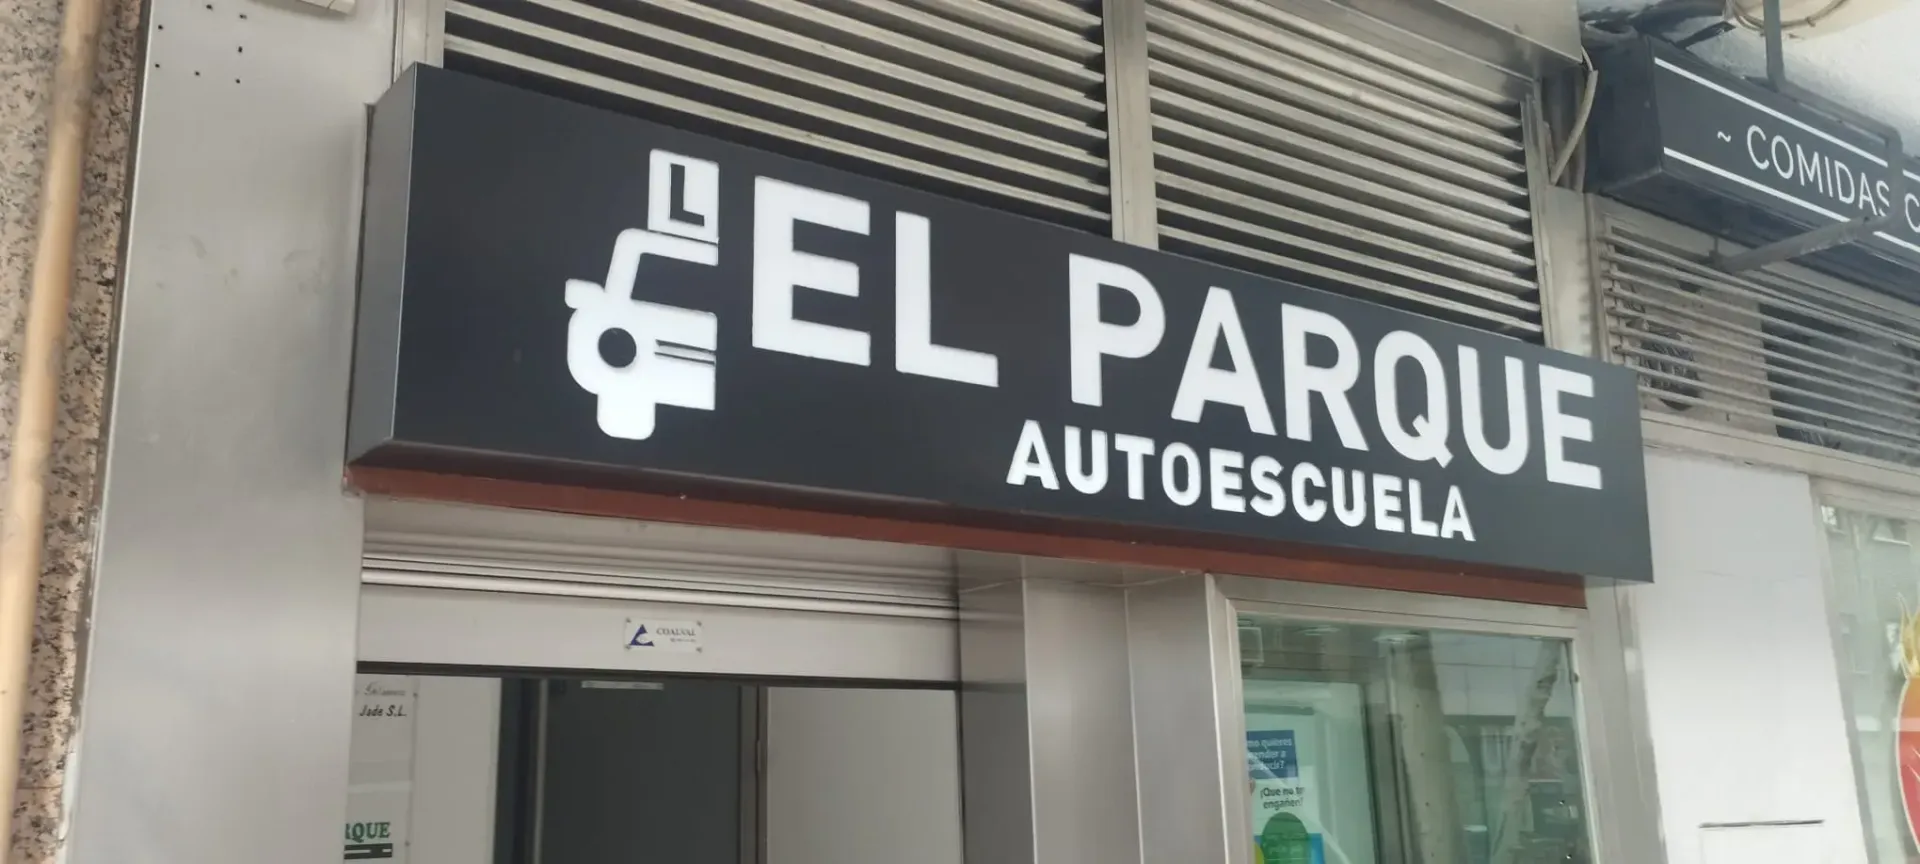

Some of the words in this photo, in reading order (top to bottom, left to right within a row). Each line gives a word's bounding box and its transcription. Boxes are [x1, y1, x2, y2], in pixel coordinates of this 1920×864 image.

[669, 163, 705, 227] L
[1747, 125, 1890, 217] COMIDAS
[751, 175, 998, 387] EL
[1068, 253, 1603, 490] PARQUE
[1007, 419, 1477, 542] AUTOESCUELA
